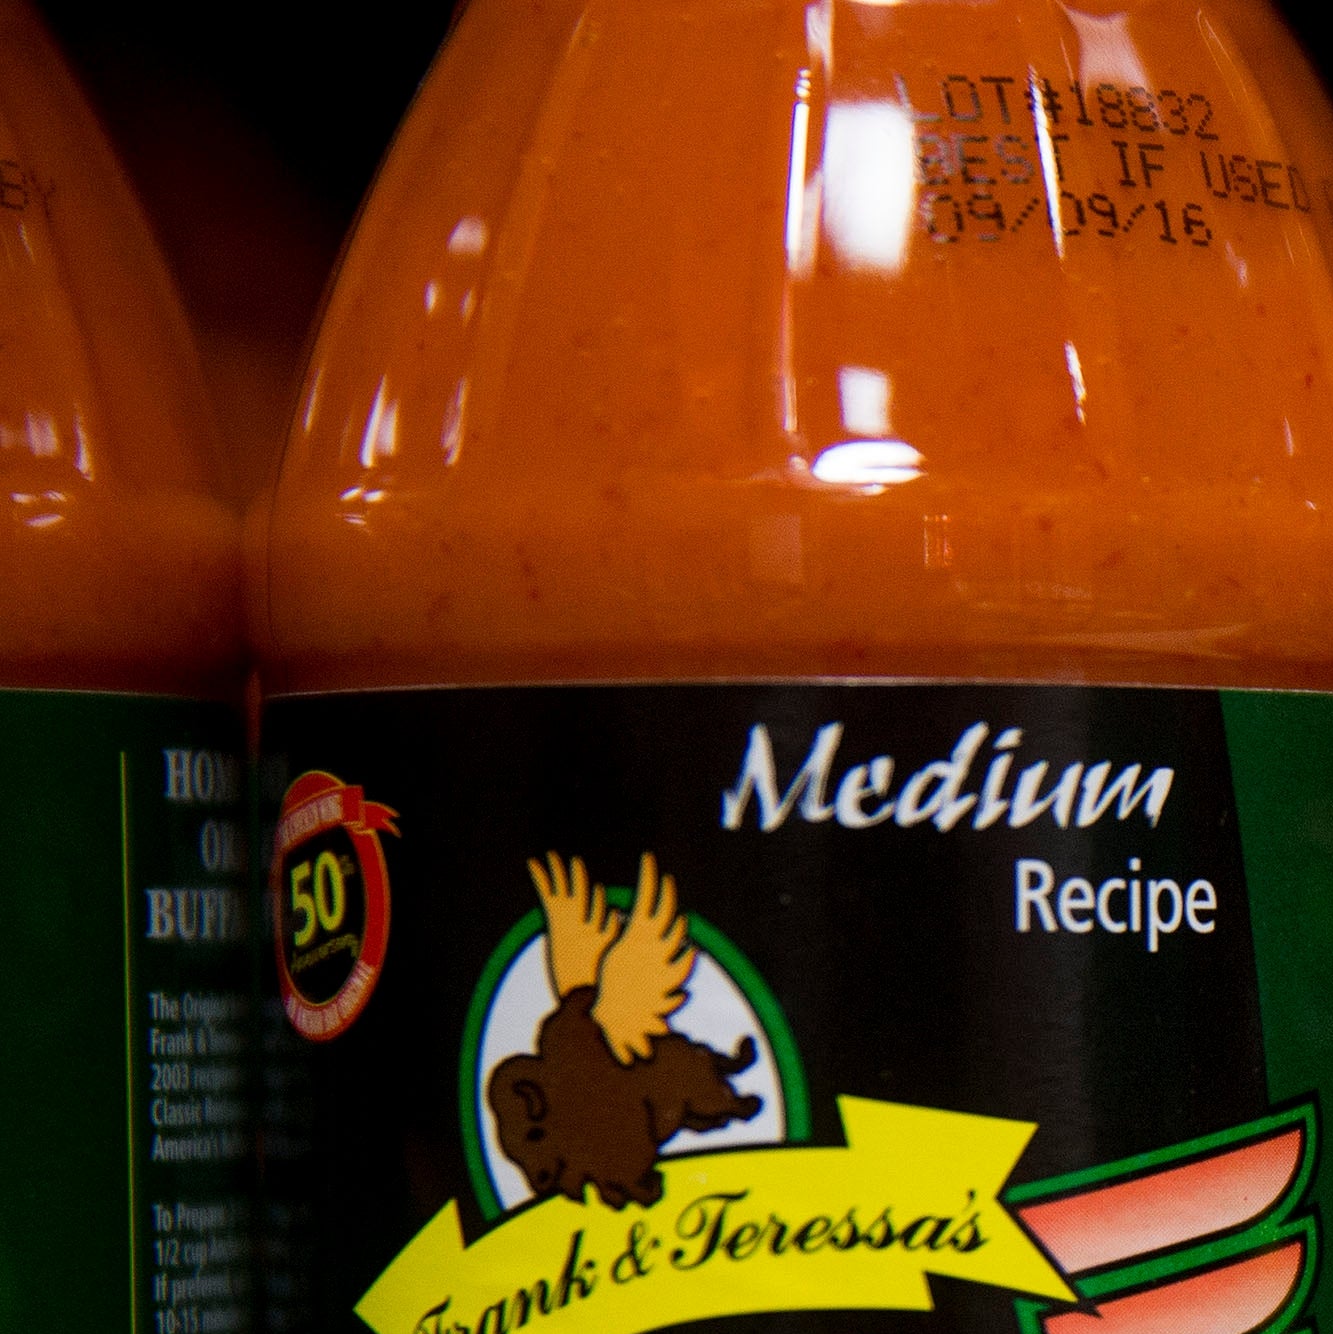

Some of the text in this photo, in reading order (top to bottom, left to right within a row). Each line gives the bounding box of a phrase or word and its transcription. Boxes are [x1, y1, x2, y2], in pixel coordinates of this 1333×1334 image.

[917, 134, 1068, 185] BEST
[1112, 139, 1164, 188] IF
[925, 189, 1213, 247] 09/09/16
[163, 747, 240, 803] HO
[722, 721, 1174, 833] Medium
[1014, 858, 1217, 952] Recipe
[150, 1063, 189, 1091] 2003
[610, 1221, 661, 1285] &
[671, 1188, 990, 1272] Teressa's
